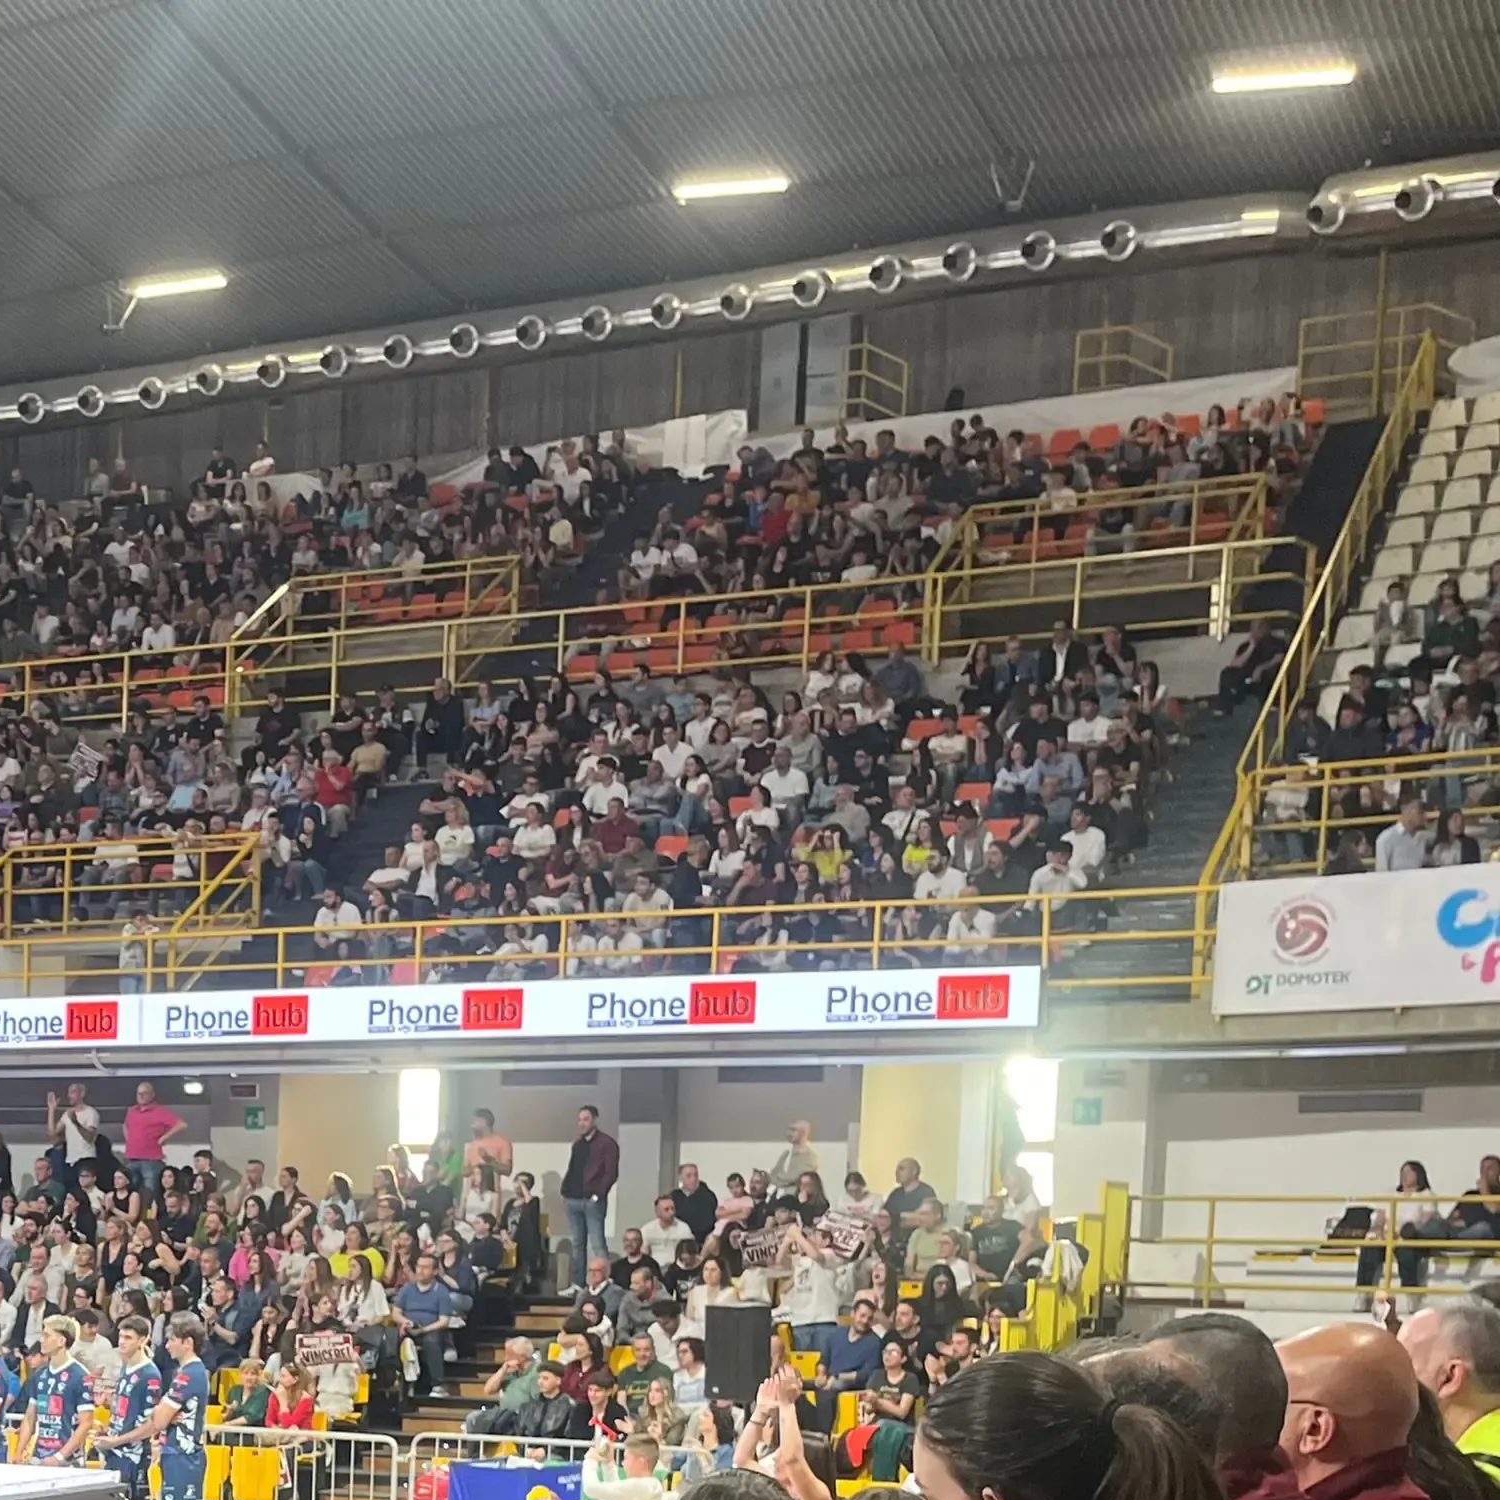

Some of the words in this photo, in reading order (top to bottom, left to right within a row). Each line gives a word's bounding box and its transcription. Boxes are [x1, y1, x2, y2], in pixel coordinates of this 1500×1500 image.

[1276, 970, 1351, 986] DOMOTEK
[368, 999, 460, 1024] Phone
[468, 997, 519, 1024] hub
[587, 992, 685, 1018] Phone
[695, 991, 751, 1018] hub
[826, 986, 933, 1012] Phone
[943, 984, 1005, 1012] hub
[70, 1009, 114, 1034] hub
[165, 1006, 249, 1029] Phone
[257, 1003, 305, 1029] hub
